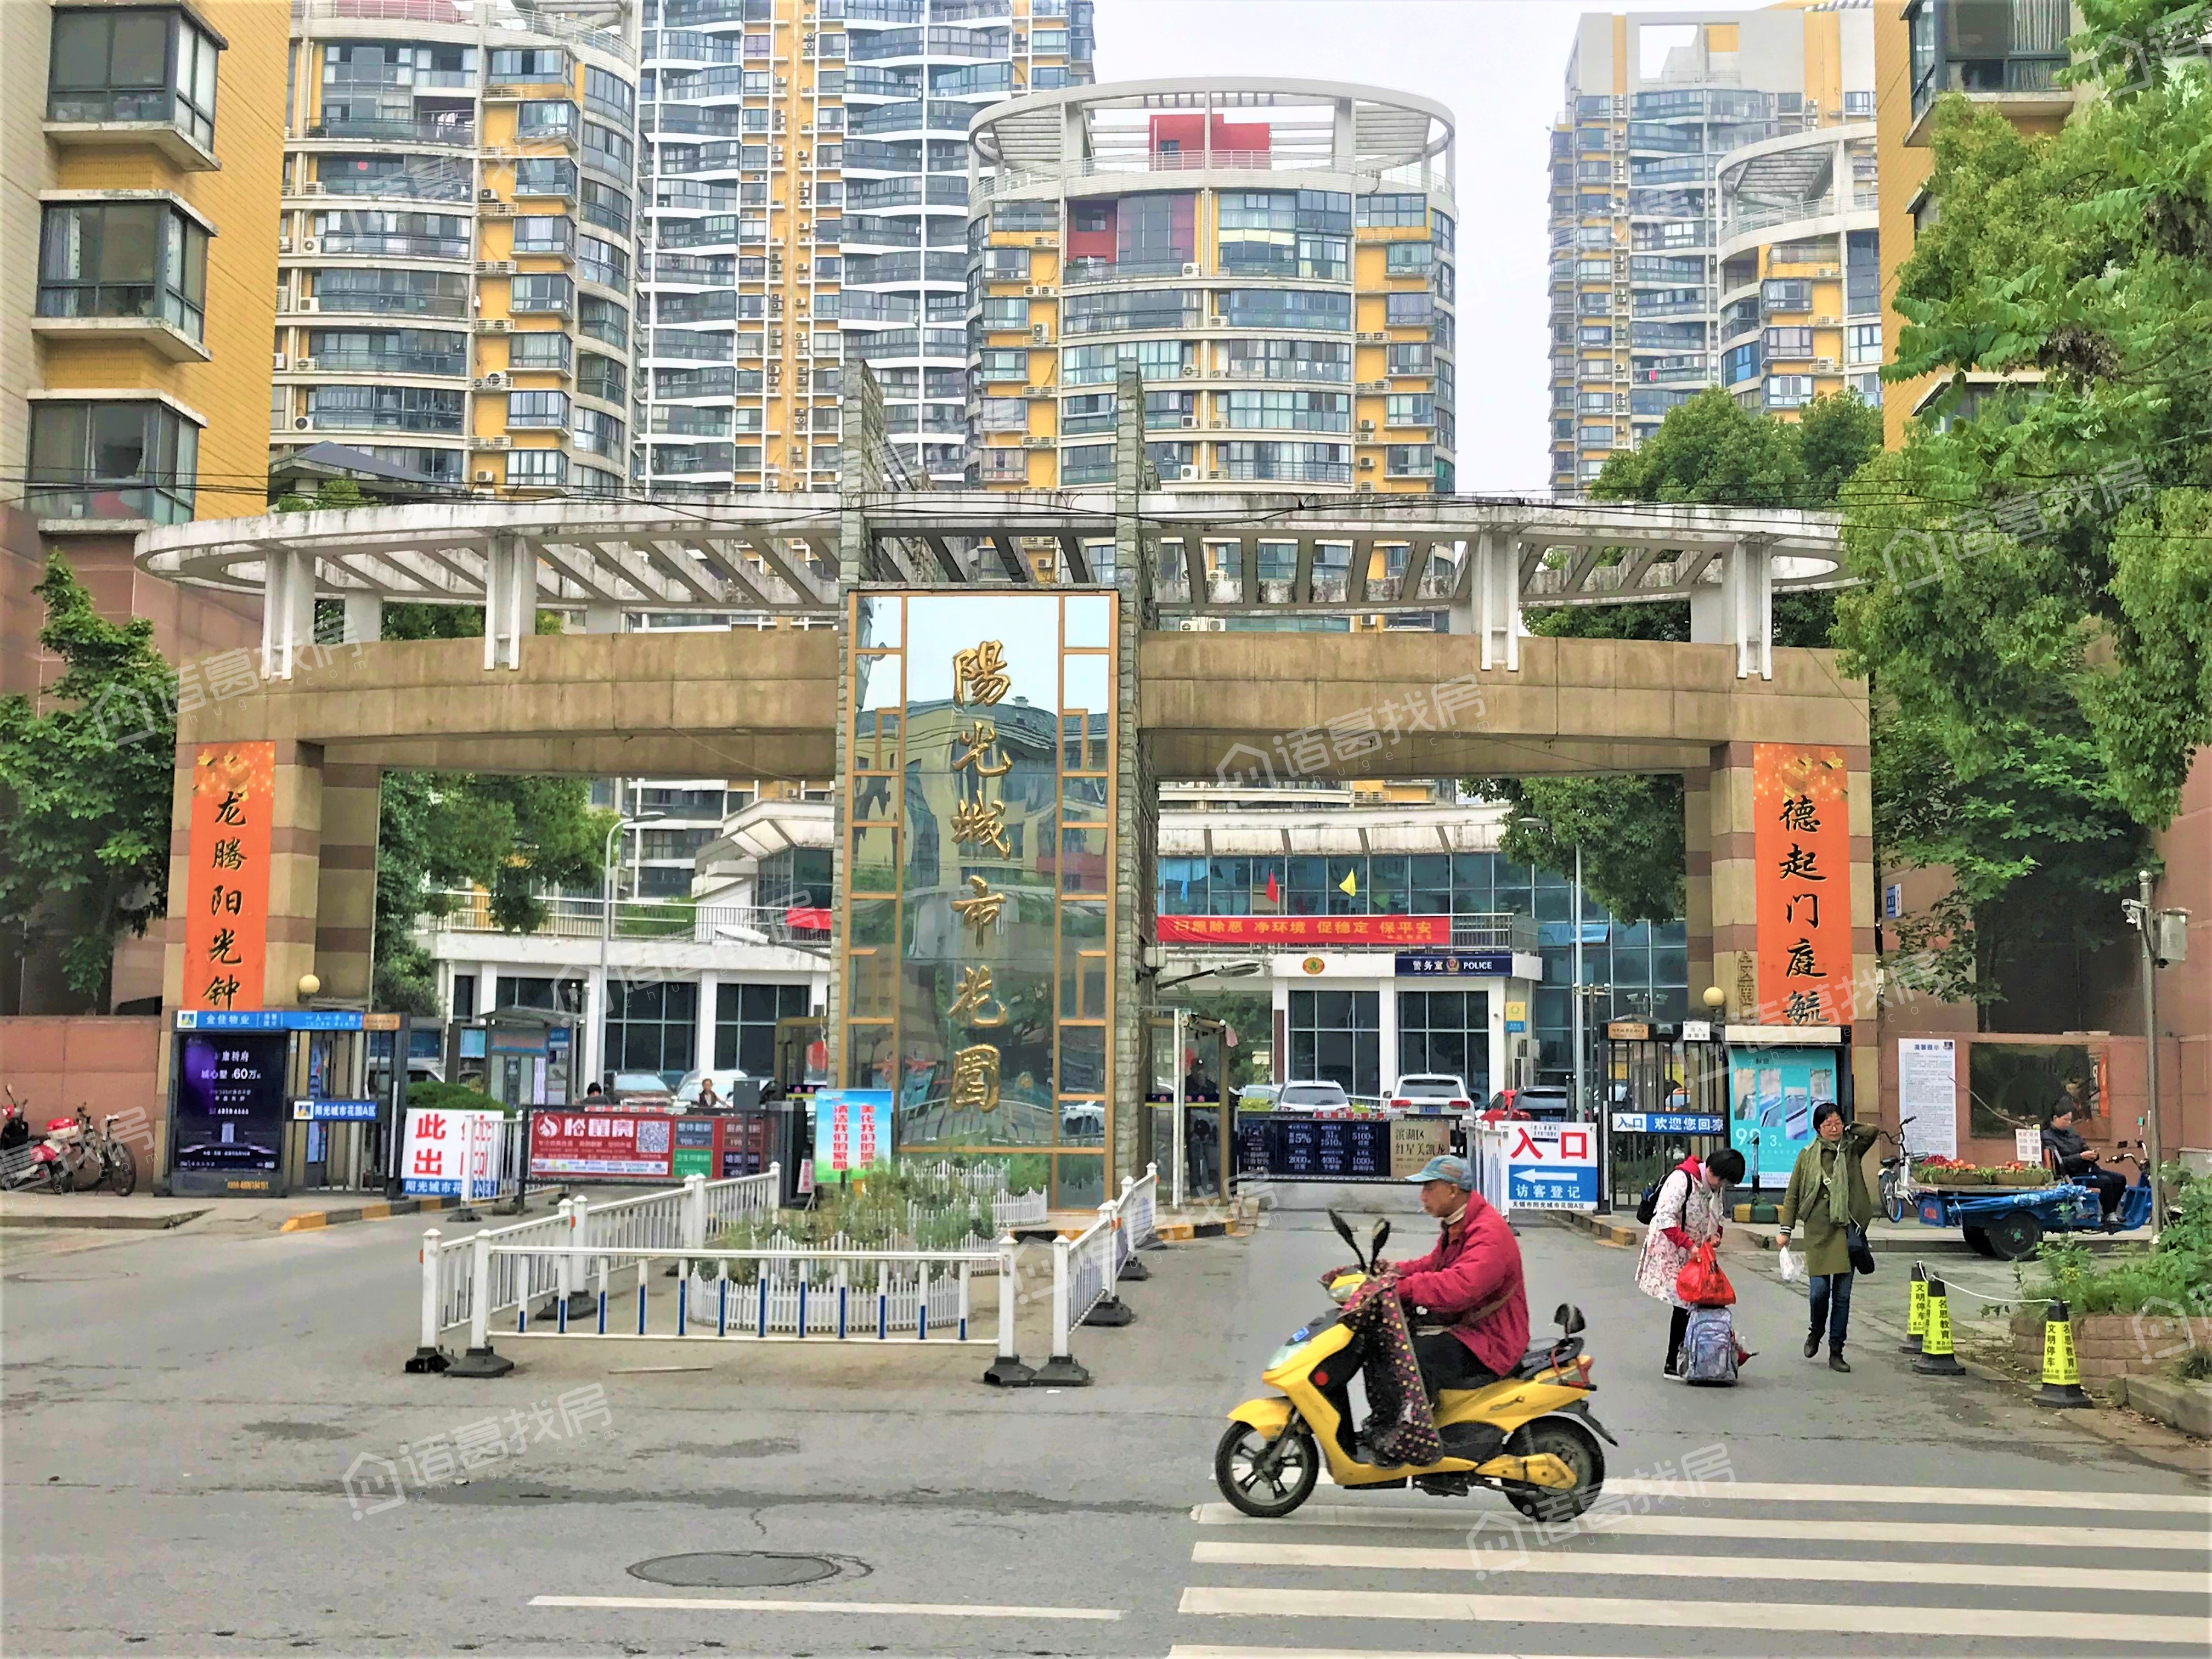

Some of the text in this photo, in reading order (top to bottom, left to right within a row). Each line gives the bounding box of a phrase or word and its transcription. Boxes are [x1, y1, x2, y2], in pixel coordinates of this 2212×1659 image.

[202, 791, 247, 1011] 龙腾阳光钟
[1779, 794, 1829, 1026] 德起门庭毓
[1254, 921, 1306, 933] 净环境
[1318, 921, 1368, 934] 促稳定
[1380, 921, 1431, 934] 保平安
[1413, 961, 1492, 970] 警务室 POLICE
[1396, 1128, 1424, 1141] 滨湖区
[1618, 1116, 1723, 1131] 入口 欢迎您回家
[1396, 1143, 1446, 1155] 红星美凯龙
[1510, 1127, 1587, 1160] 入口
[1516, 1184, 1581, 1198] 访客登记
[1915, 1283, 1926, 1320] 文明停车
[2046, 1324, 2056, 1367] 文明停车
[2063, 1324, 2074, 1367] 名思教育
